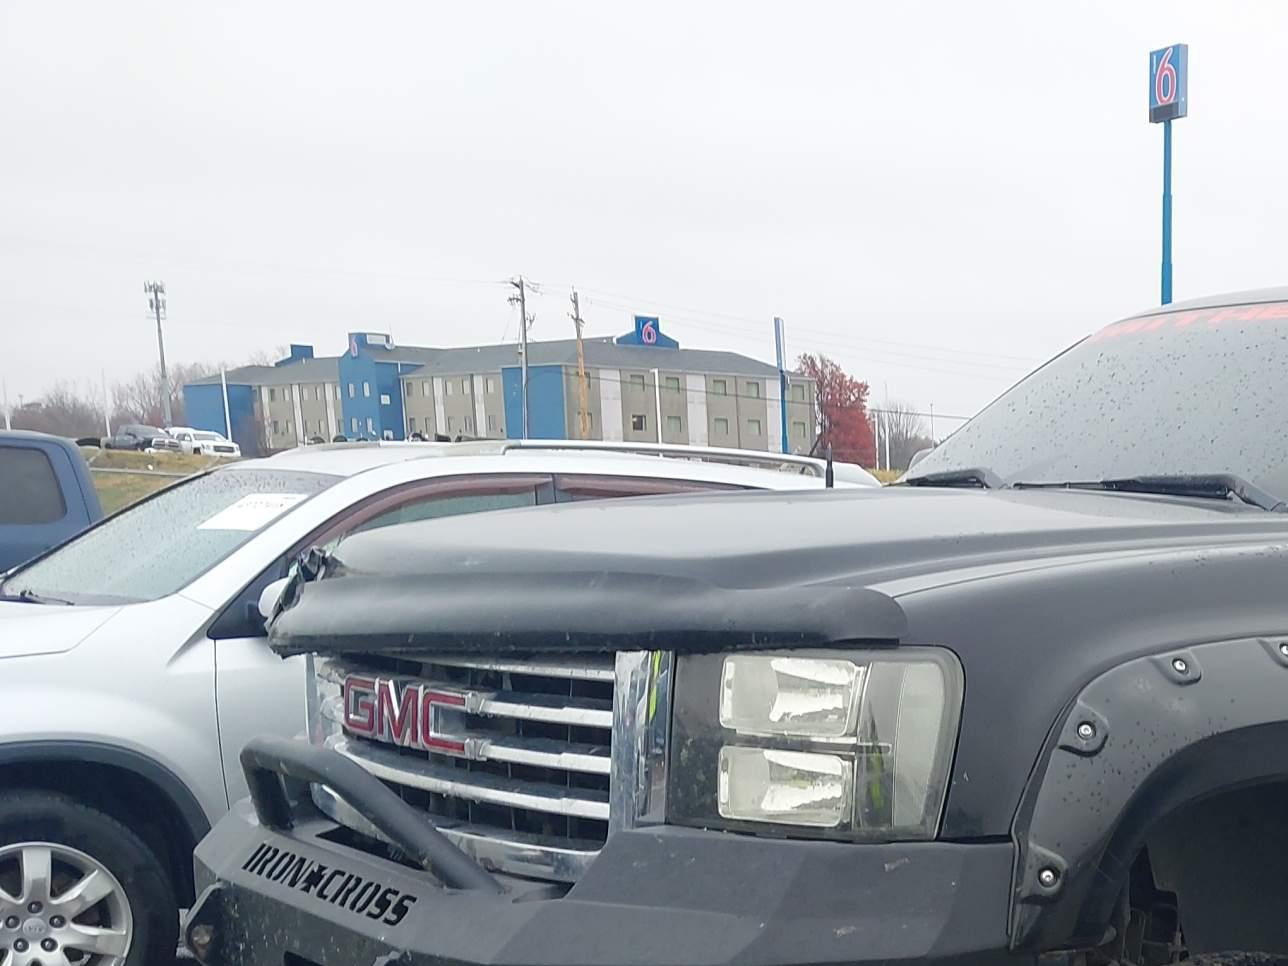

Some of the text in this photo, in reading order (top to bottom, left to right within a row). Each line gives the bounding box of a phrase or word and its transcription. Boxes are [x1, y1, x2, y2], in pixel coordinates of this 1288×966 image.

[1156, 47, 1177, 105] 6
[641, 320, 657, 344] 6
[344, 674, 467, 758] GMC
[241, 843, 418, 926] IRON CROSS
